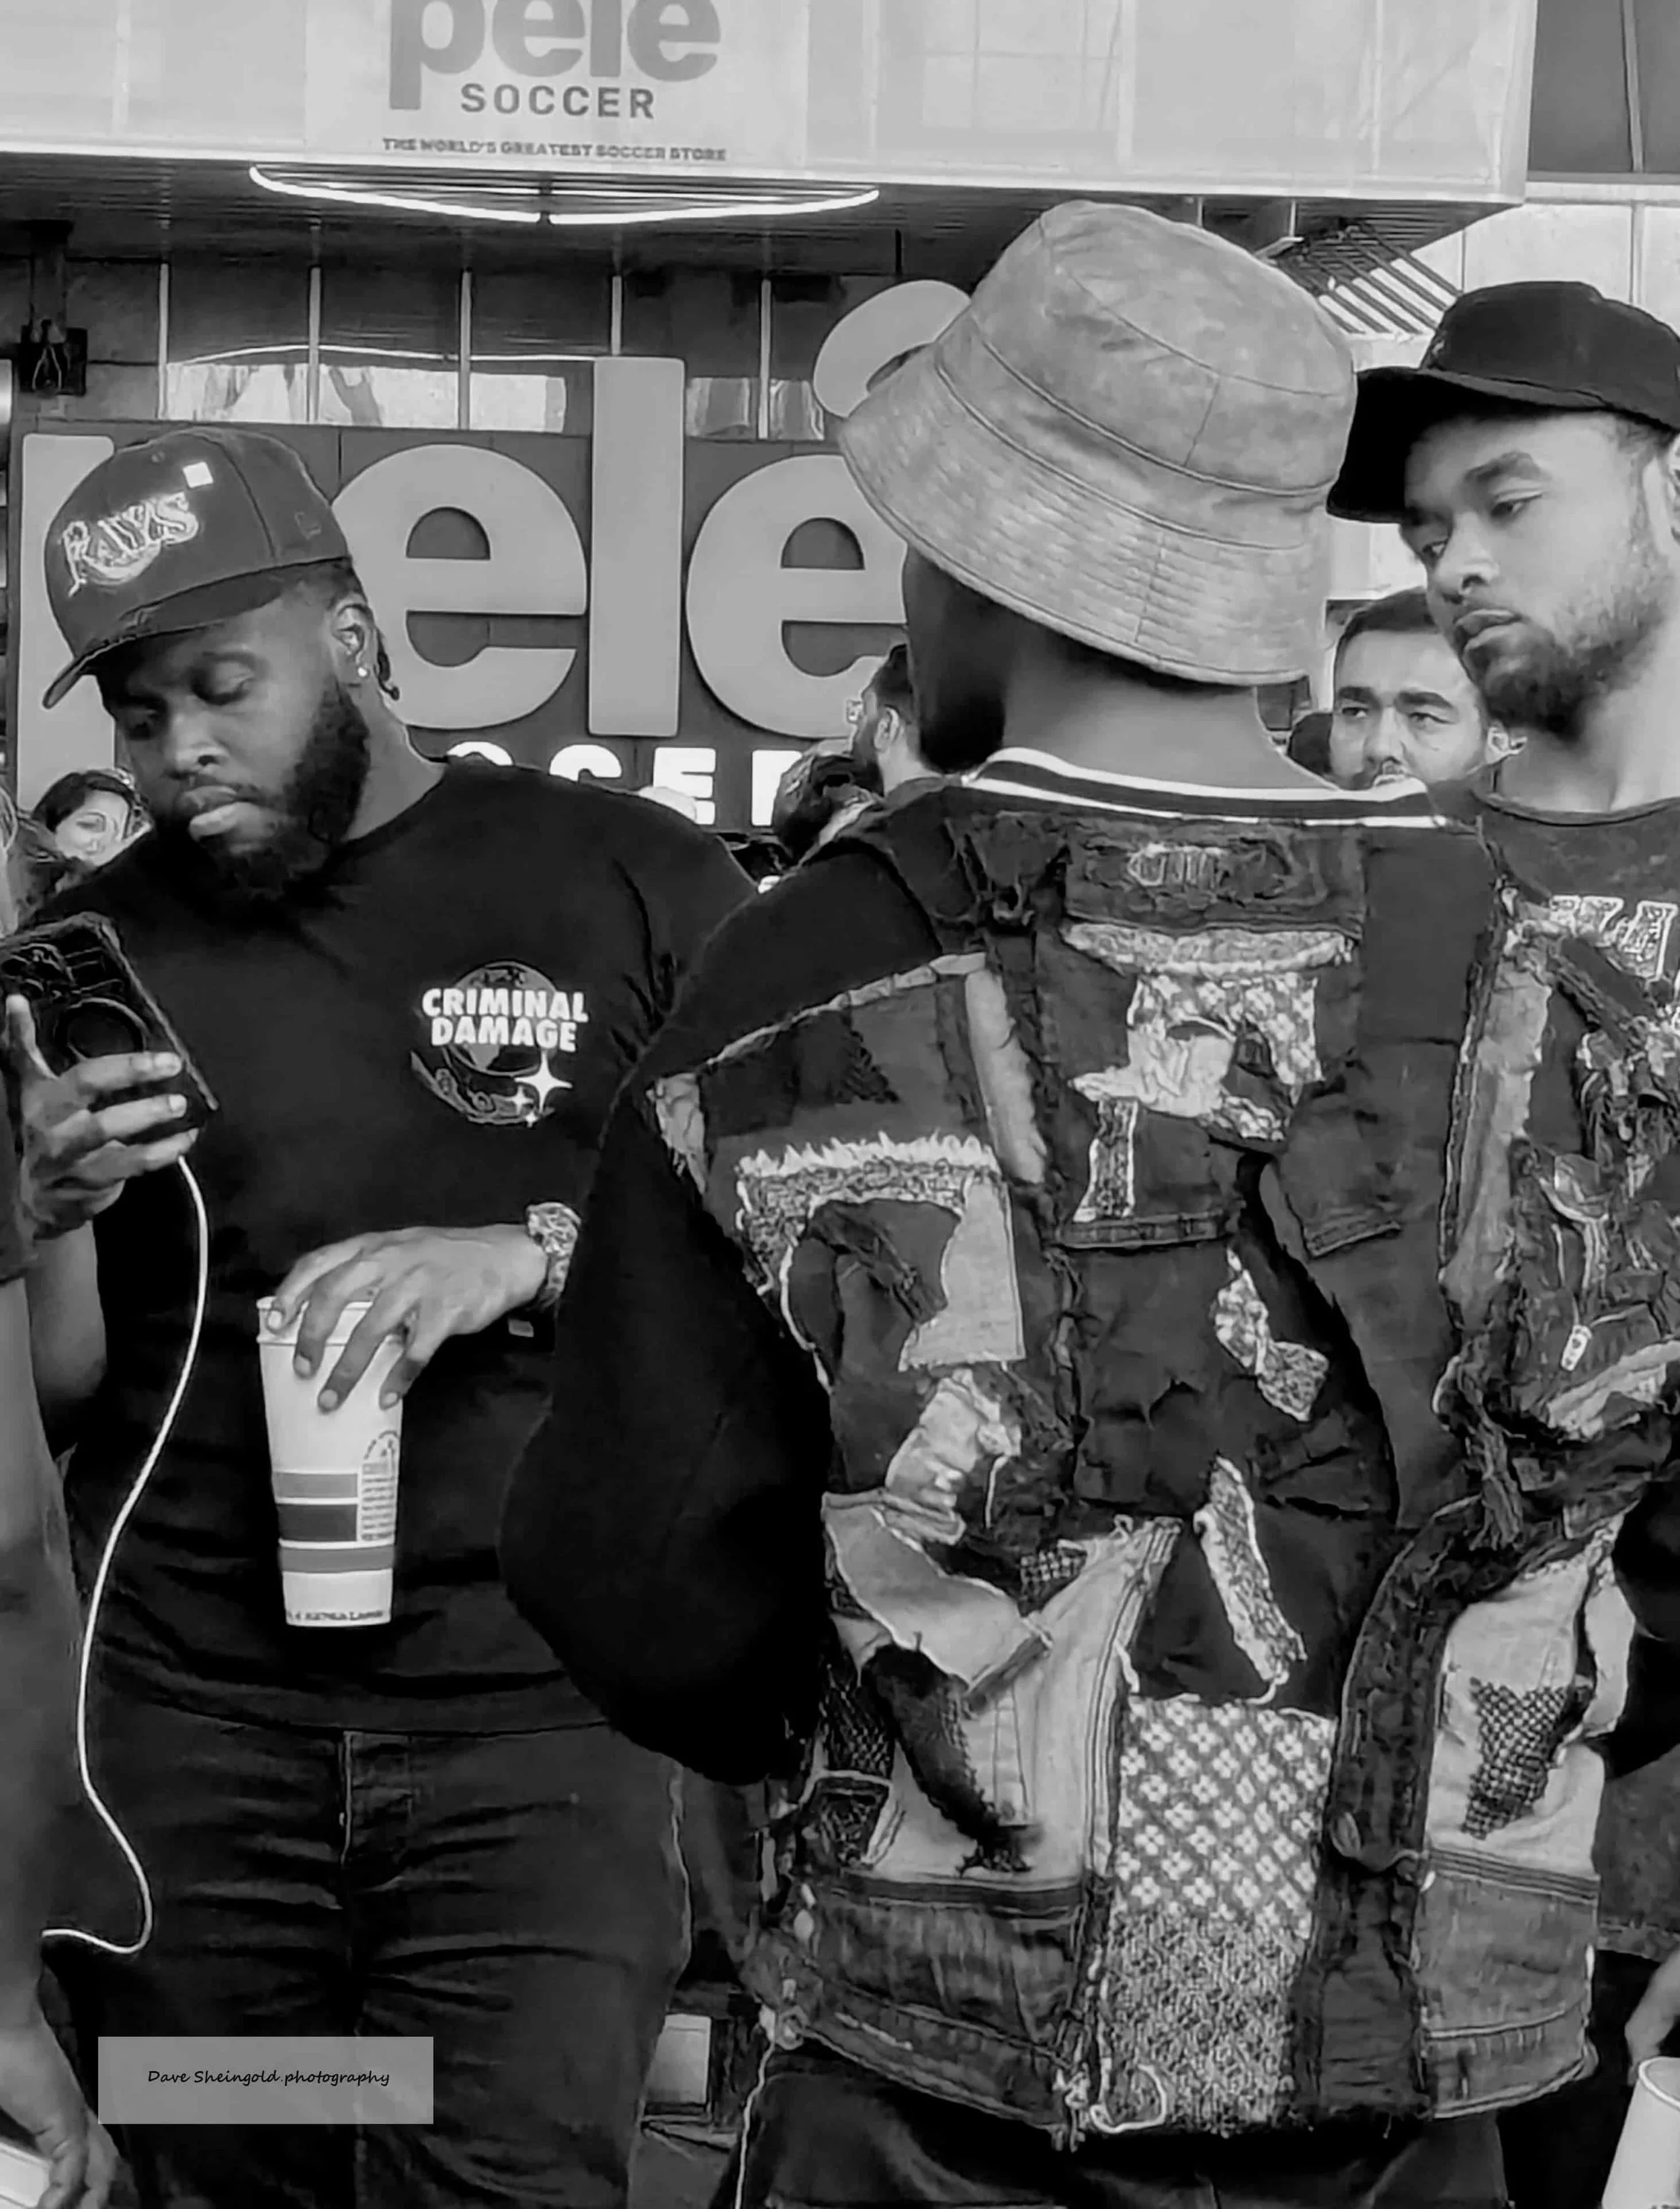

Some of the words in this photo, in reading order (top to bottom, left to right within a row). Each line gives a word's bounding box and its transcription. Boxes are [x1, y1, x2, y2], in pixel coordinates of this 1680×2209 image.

[460, 82, 655, 120] SOCCER
[382, 137, 417, 151] THE
[419, 139, 497, 154] WORLD'S
[500, 141, 593, 157] GREATEST
[595, 144, 666, 160] SOCCER
[669, 147, 726, 162] STORE
[421, 987, 589, 1023] CRIMINAL
[431, 1015, 578, 1052] DAMAGE
